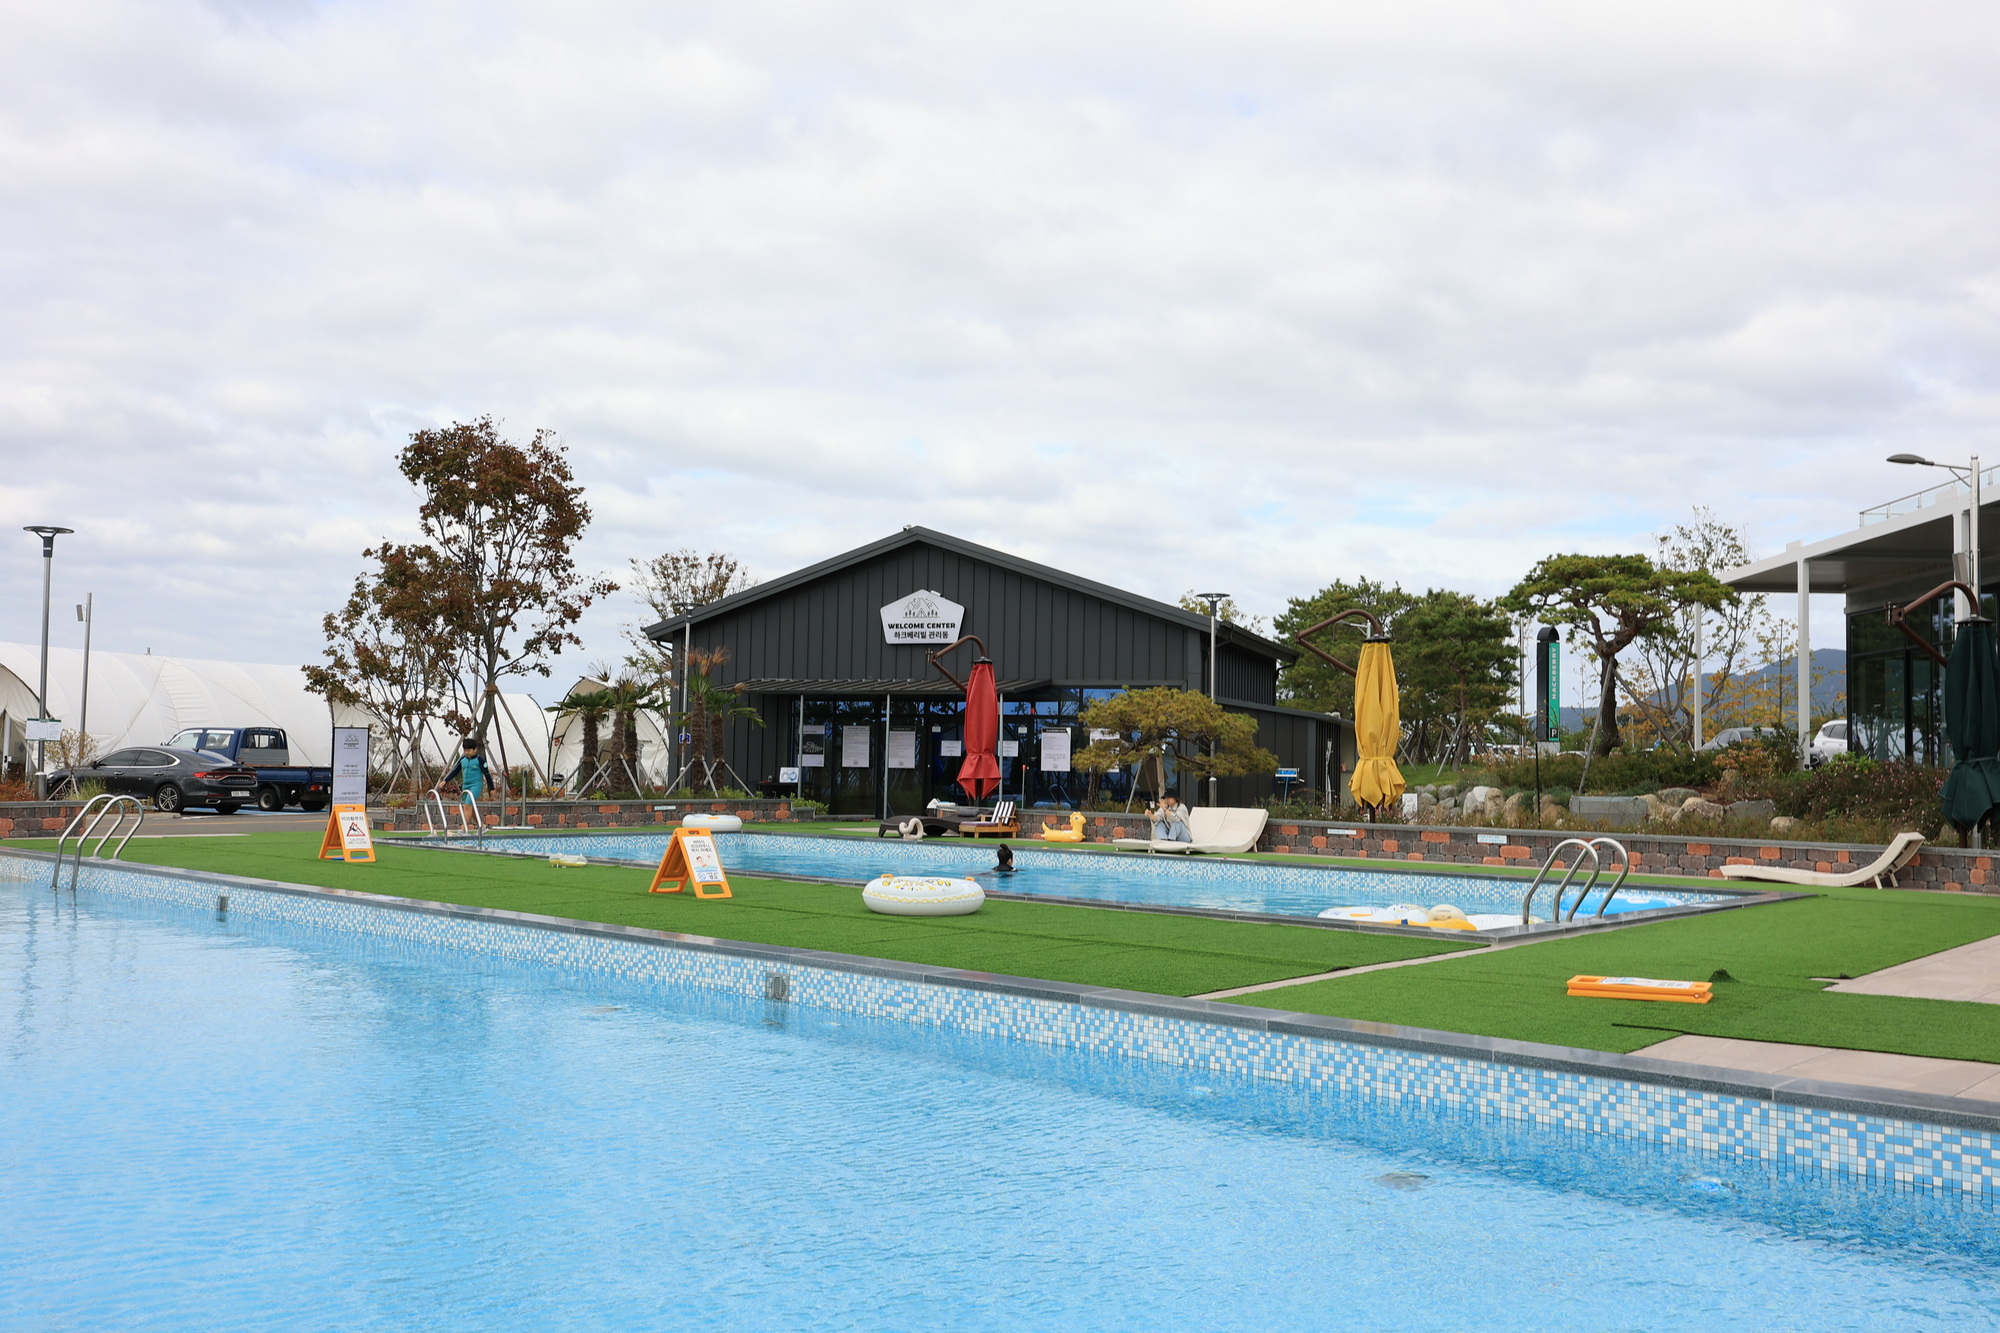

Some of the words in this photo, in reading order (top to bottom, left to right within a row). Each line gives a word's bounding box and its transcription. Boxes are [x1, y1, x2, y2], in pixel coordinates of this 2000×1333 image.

[894, 631, 927, 640] 하크베리빌
[928, 631, 949, 640] 관리동
[1551, 728, 1557, 738] P
